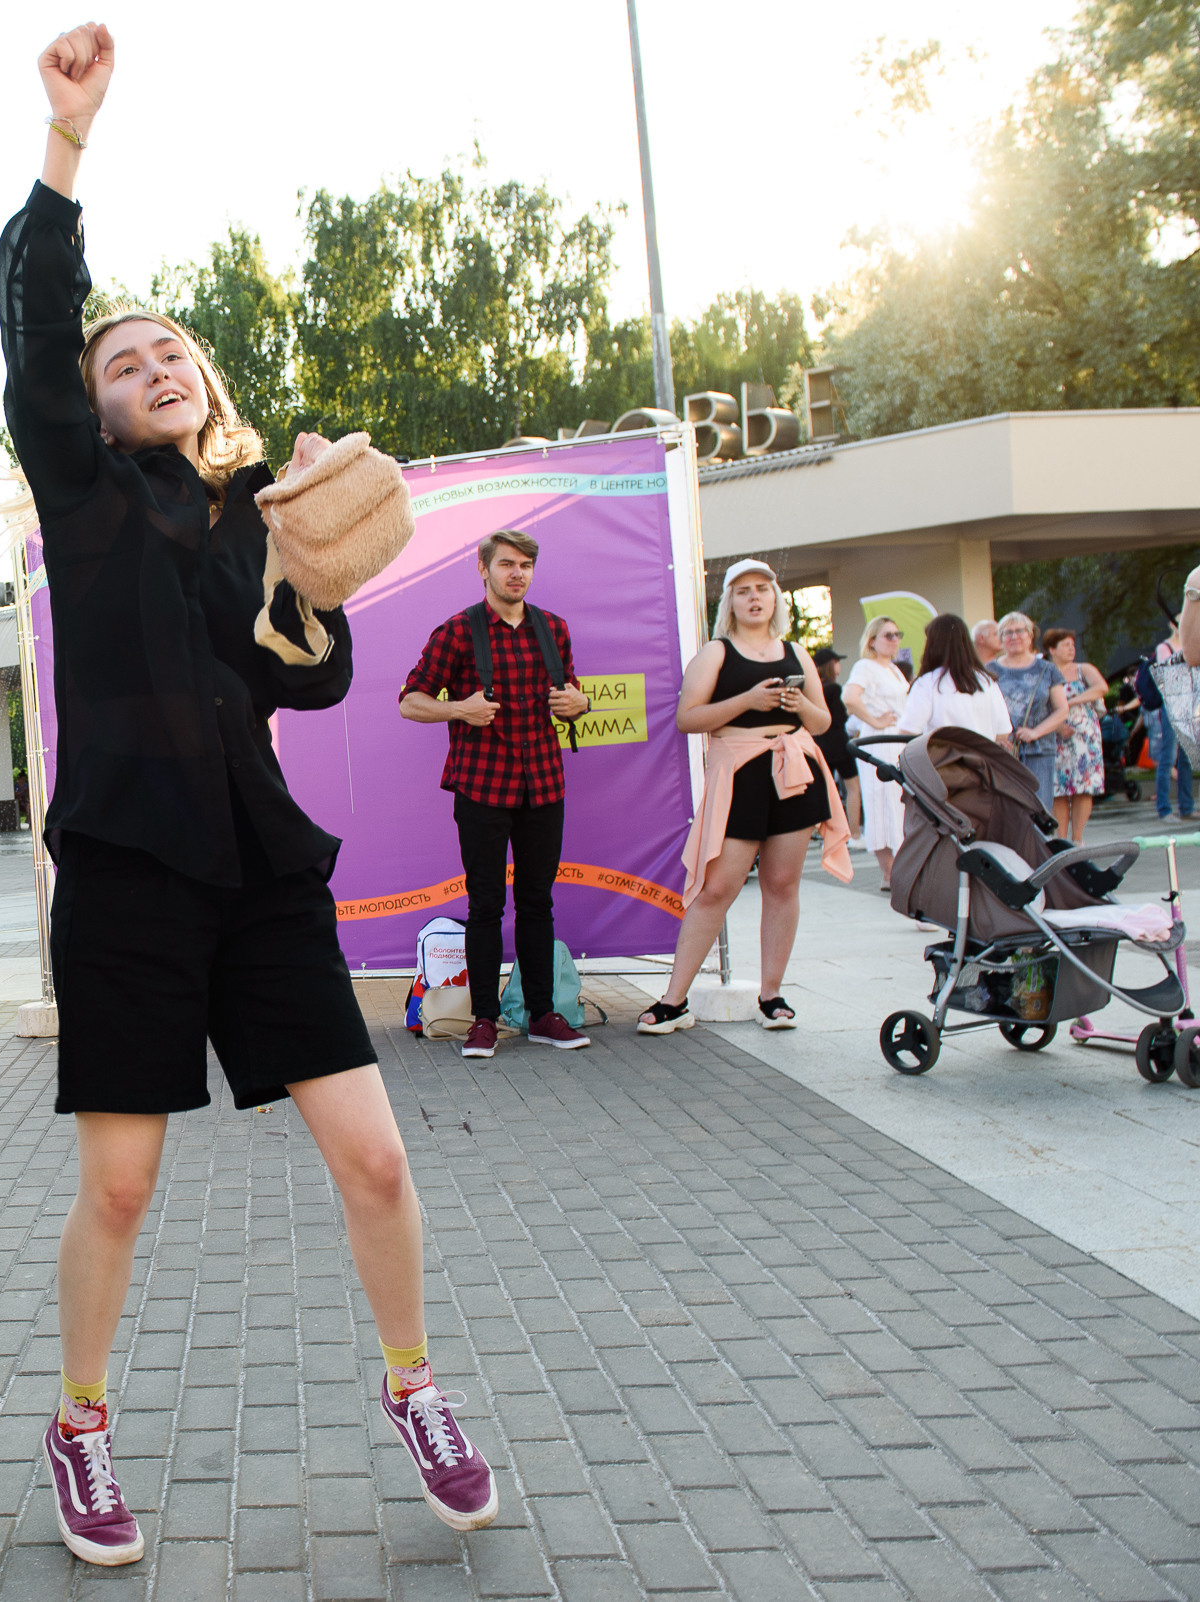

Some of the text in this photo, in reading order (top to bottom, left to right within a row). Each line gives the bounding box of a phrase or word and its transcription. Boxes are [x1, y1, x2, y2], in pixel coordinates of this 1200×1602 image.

[411, 477, 667, 513] ТРЕ НОВЫХ ВОЗМОЖНОСТЕЙ В ЦЕНТРЕ НО
[582, 683, 626, 701] НАЯ
[555, 717, 637, 740] РАММА
[336, 905, 356, 916] ЬТЕ
[359, 893, 431, 913] МОЛОДОСТЬ
[443, 880, 465, 896] #ОТ
[598, 872, 662, 900] #ОТМЕТЬТЕ
